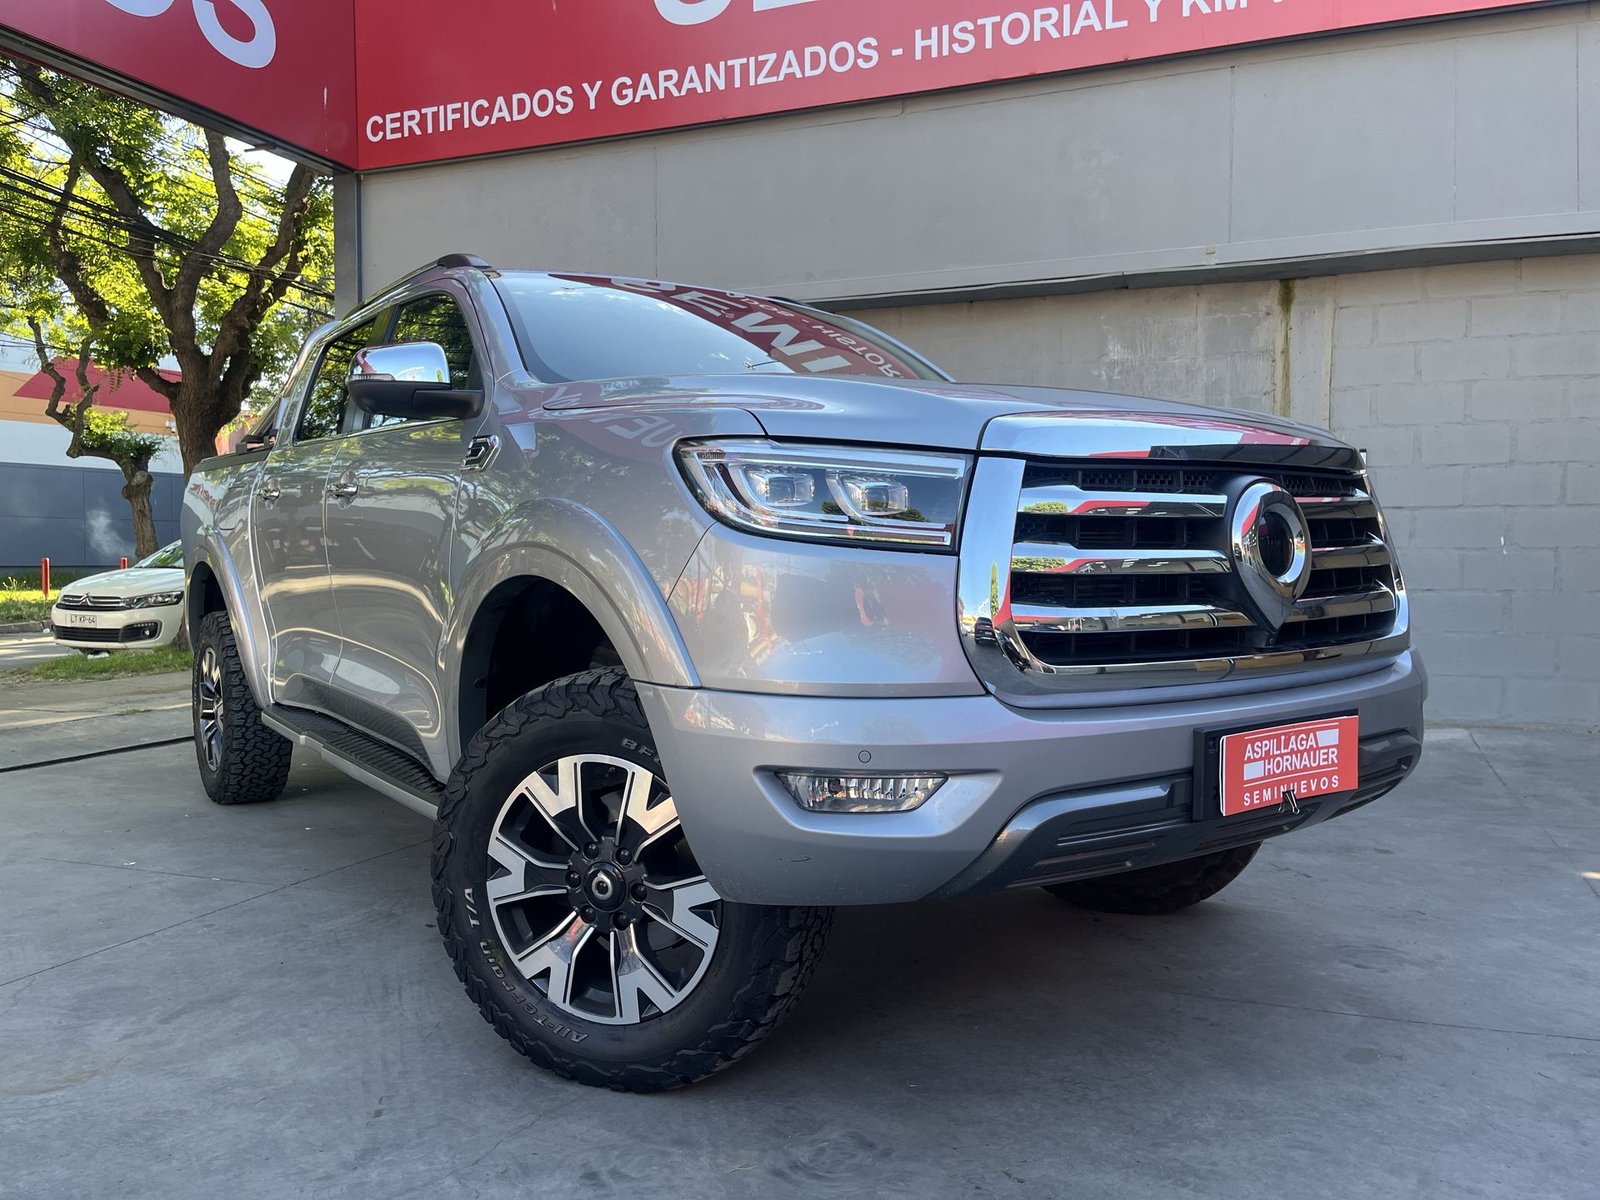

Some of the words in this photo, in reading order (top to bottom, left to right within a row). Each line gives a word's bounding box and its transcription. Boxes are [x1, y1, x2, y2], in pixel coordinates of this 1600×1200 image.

[366, 85, 574, 143] CERTIFICADOS
[582, 80, 602, 110] Y
[611, 37, 879, 105] GARANTIZADOS
[915, 0, 1128, 60] HISTORIAL
[1244, 732, 1317, 761] ASPILLAGA
[1265, 748, 1338, 776] HORNAUER
